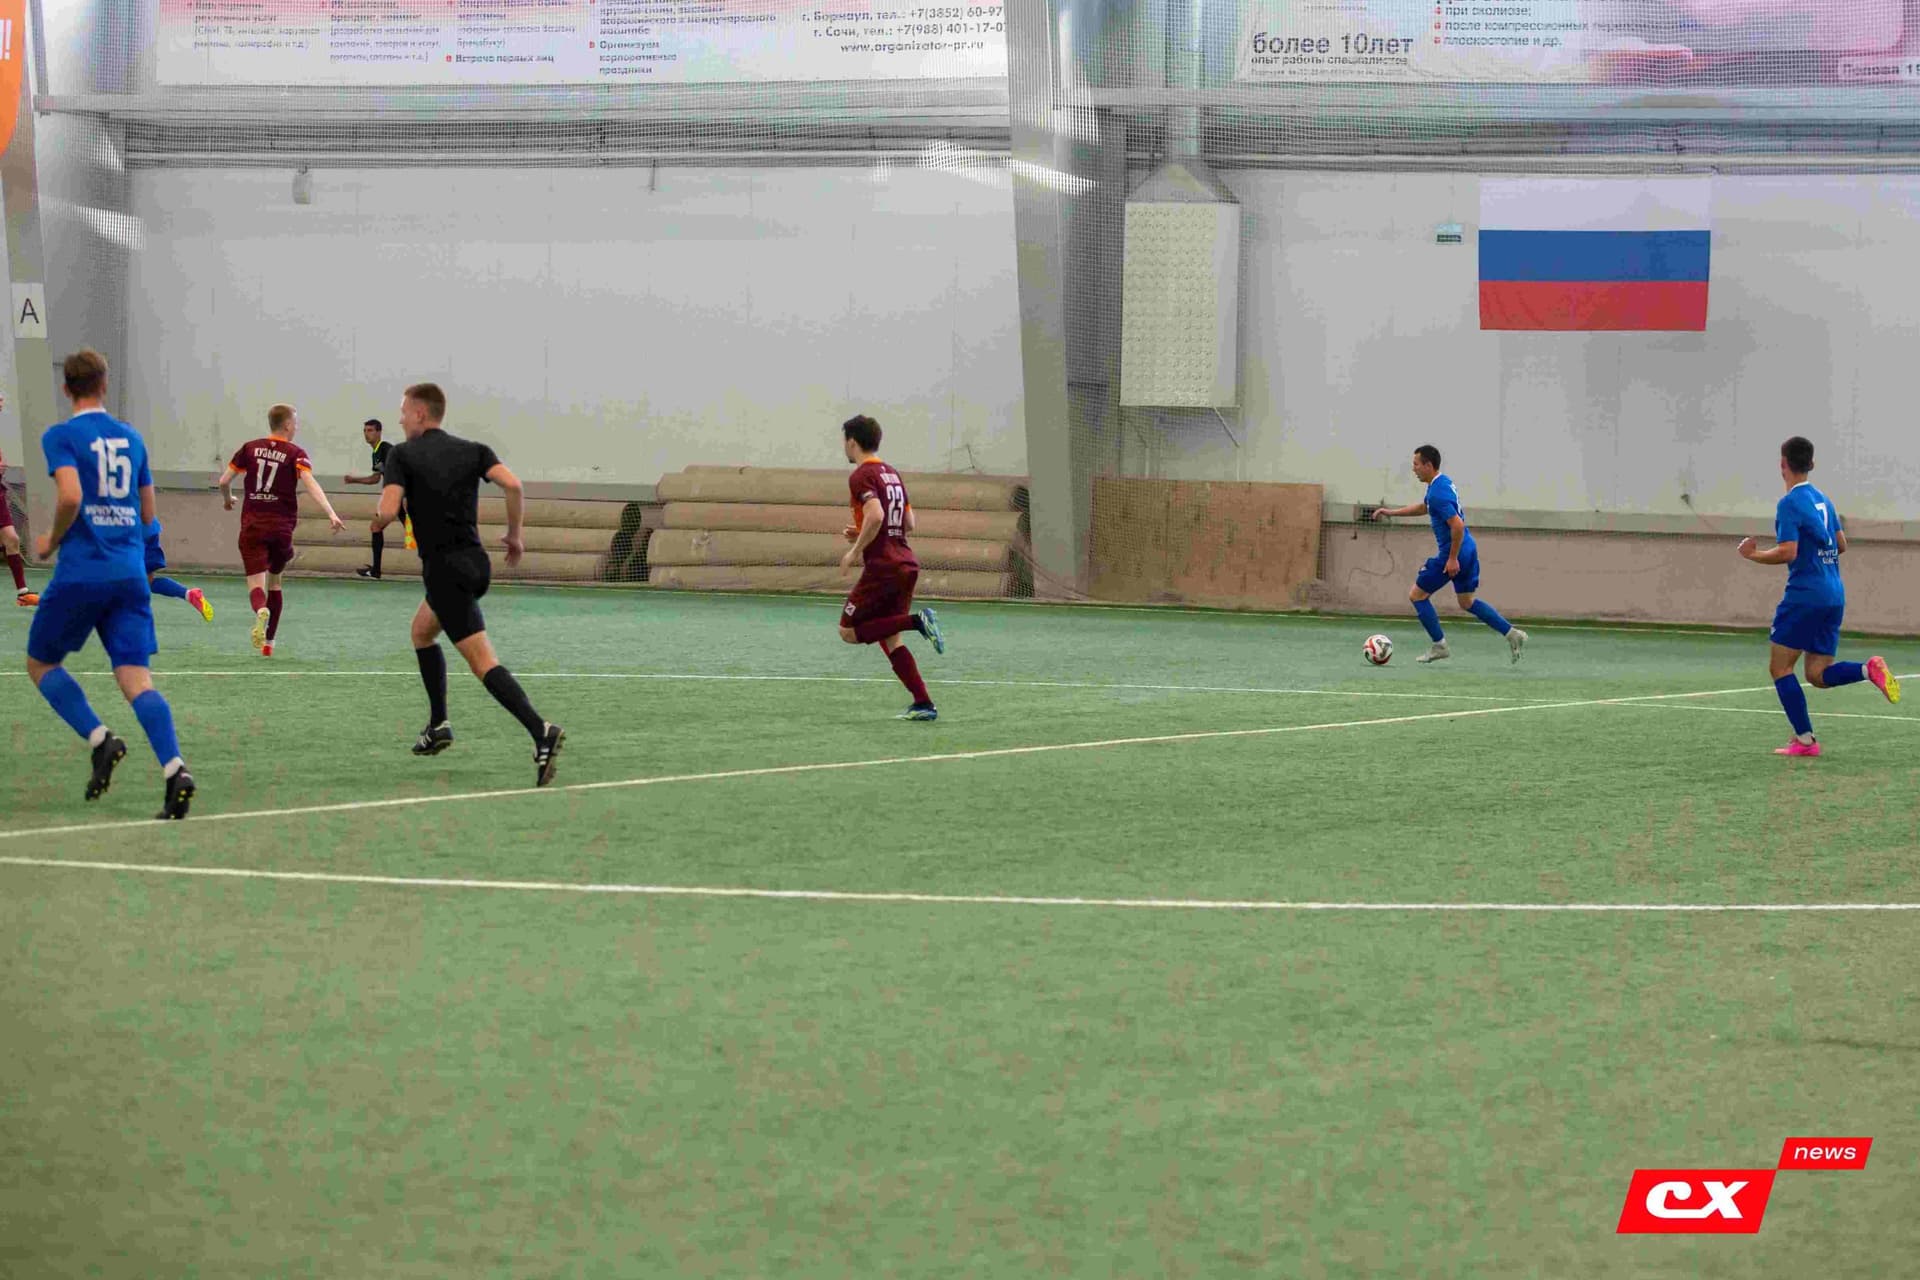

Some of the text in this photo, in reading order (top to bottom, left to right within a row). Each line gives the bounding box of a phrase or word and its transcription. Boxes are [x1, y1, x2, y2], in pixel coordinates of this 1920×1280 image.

[813, 10, 873, 23] Барнаул,
[909, 7, 963, 20] +7(3852)
[1445, 5, 1532, 16] при сколиозе;
[825, 26, 860, 38] Сочи,
[896, 23, 943, 36] +7(988)
[1445, 21, 1480, 30] после
[1484, 20, 1588, 32] компрессионных
[599, 40, 660, 51] Организуем
[1253, 32, 1330, 54] более
[1444, 35, 1562, 47] плоскостопие и др.
[455, 54, 555, 63] Встреча первых лиц
[599, 54, 677, 63] корпоративные
[1251, 54, 1408, 65] опыт работы специалистов
[599, 67, 652, 76] праздники
[90, 436, 132, 499] 15
[256, 458, 279, 493] 17
[886, 485, 905, 527] 23
[1815, 502, 1833, 546] 7
